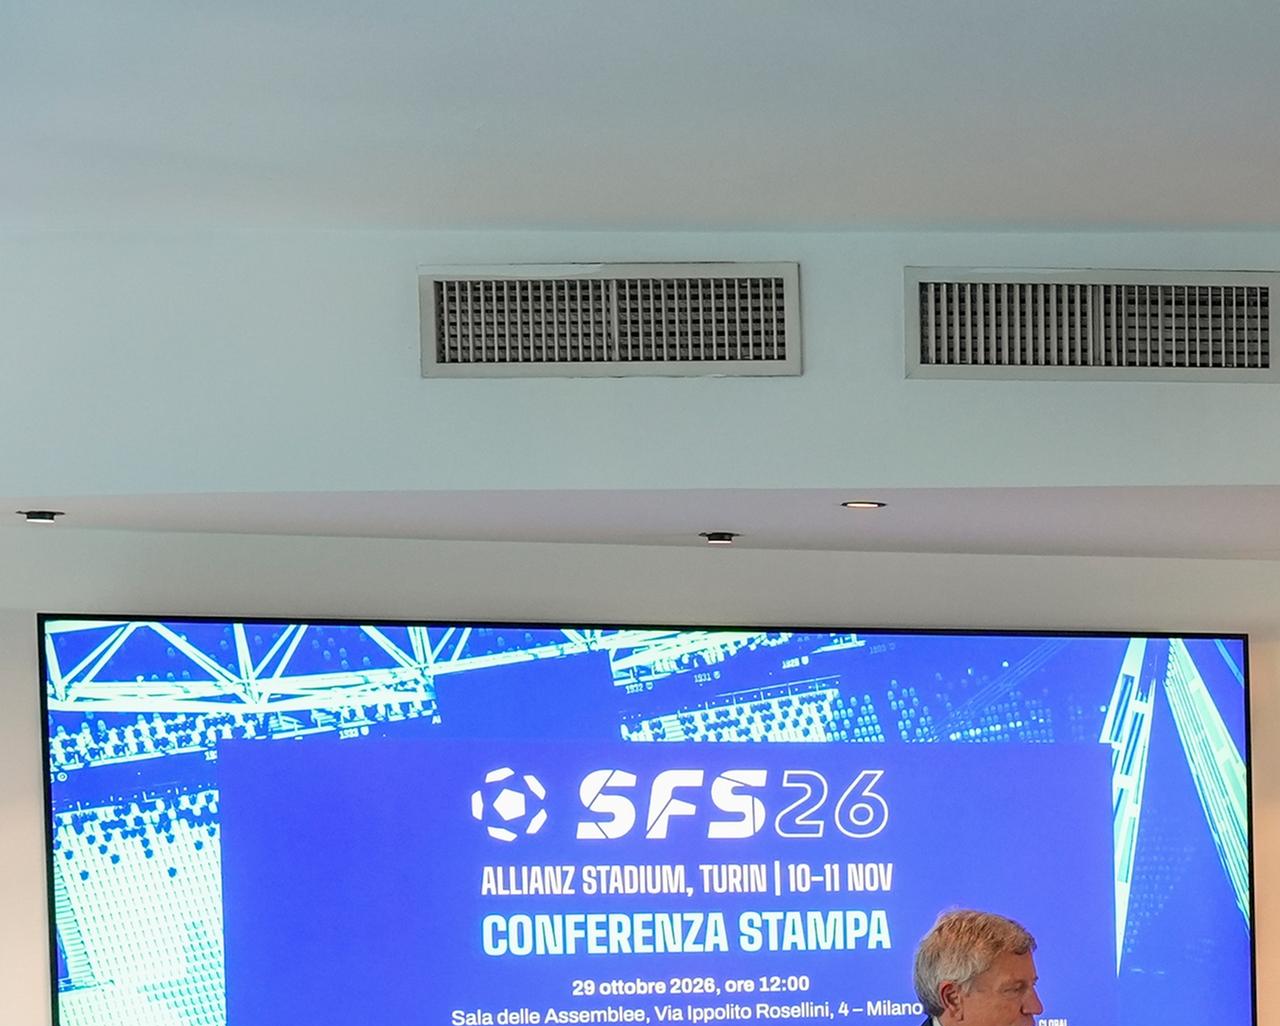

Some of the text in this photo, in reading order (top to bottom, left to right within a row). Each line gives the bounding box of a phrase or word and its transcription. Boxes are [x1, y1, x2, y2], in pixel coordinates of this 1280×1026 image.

[576, 769, 888, 839] SFS26
[481, 866, 575, 895] ALLIANZ
[583, 865, 694, 897] STADIUM,
[699, 864, 766, 893] TURIN
[848, 863, 893, 891] NOV
[482, 910, 891, 956] CONFERENZA STAMPA
[572, 976, 810, 996] 29 ottobre 2026, ore 12:00
[451, 1008, 493, 1026] Sala
[498, 1007, 540, 1025] delle
[544, 1005, 650, 1025] Assemblee,
[653, 1005, 682, 1021] Via
[687, 1004, 752, 1024] Ippolito
[756, 1002, 834, 1022] Rosellini,
[839, 1003, 849, 1017] 4
[867, 999, 923, 1016] Milano
